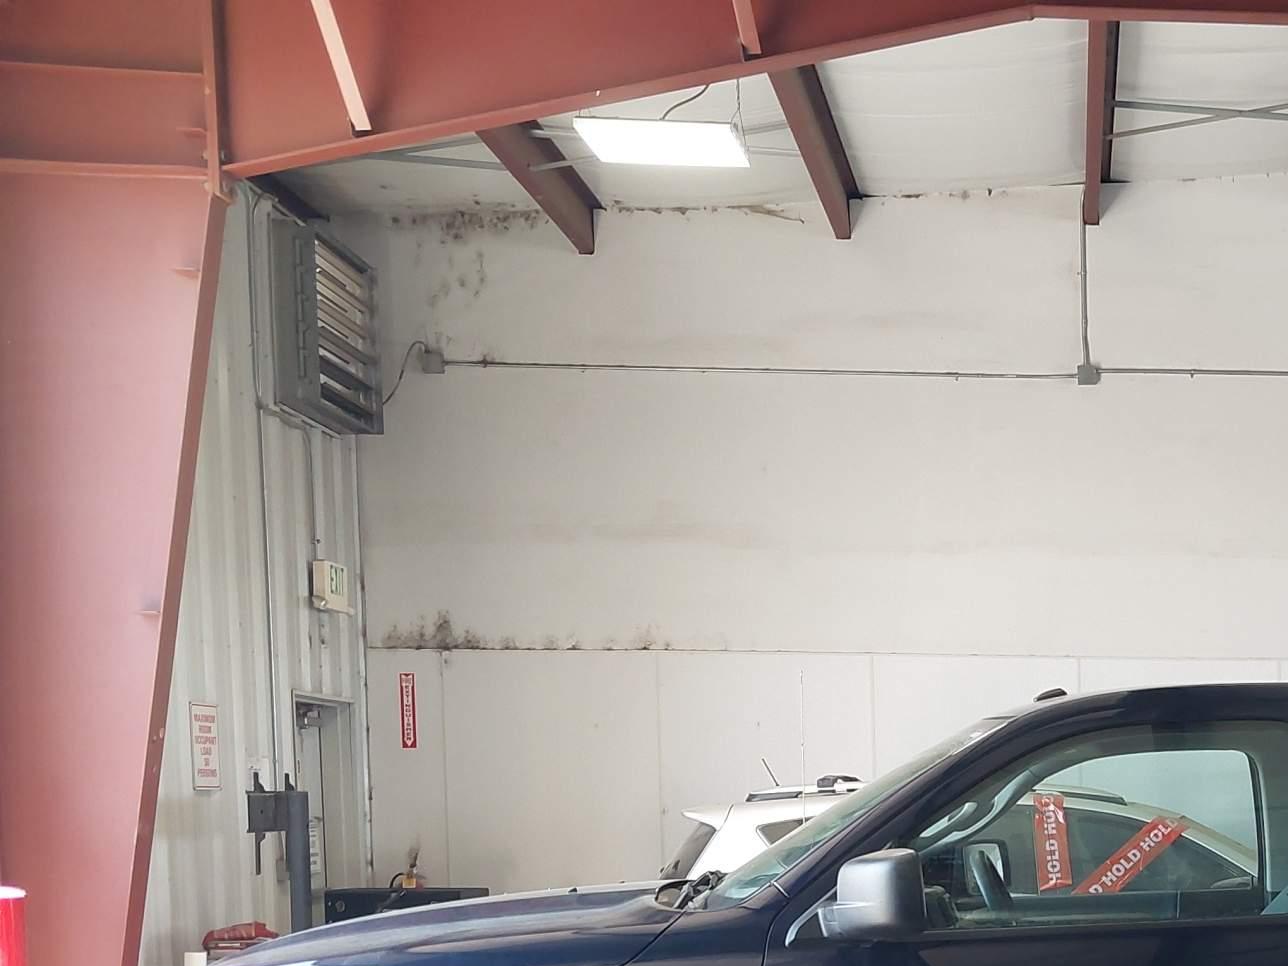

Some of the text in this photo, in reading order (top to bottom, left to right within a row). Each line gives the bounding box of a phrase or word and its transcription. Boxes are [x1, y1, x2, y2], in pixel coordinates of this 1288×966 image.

[330, 564, 344, 596] EXIT
[1045, 839, 1062, 884] HOLD
[1101, 819, 1178, 886] HOLD HOLD
